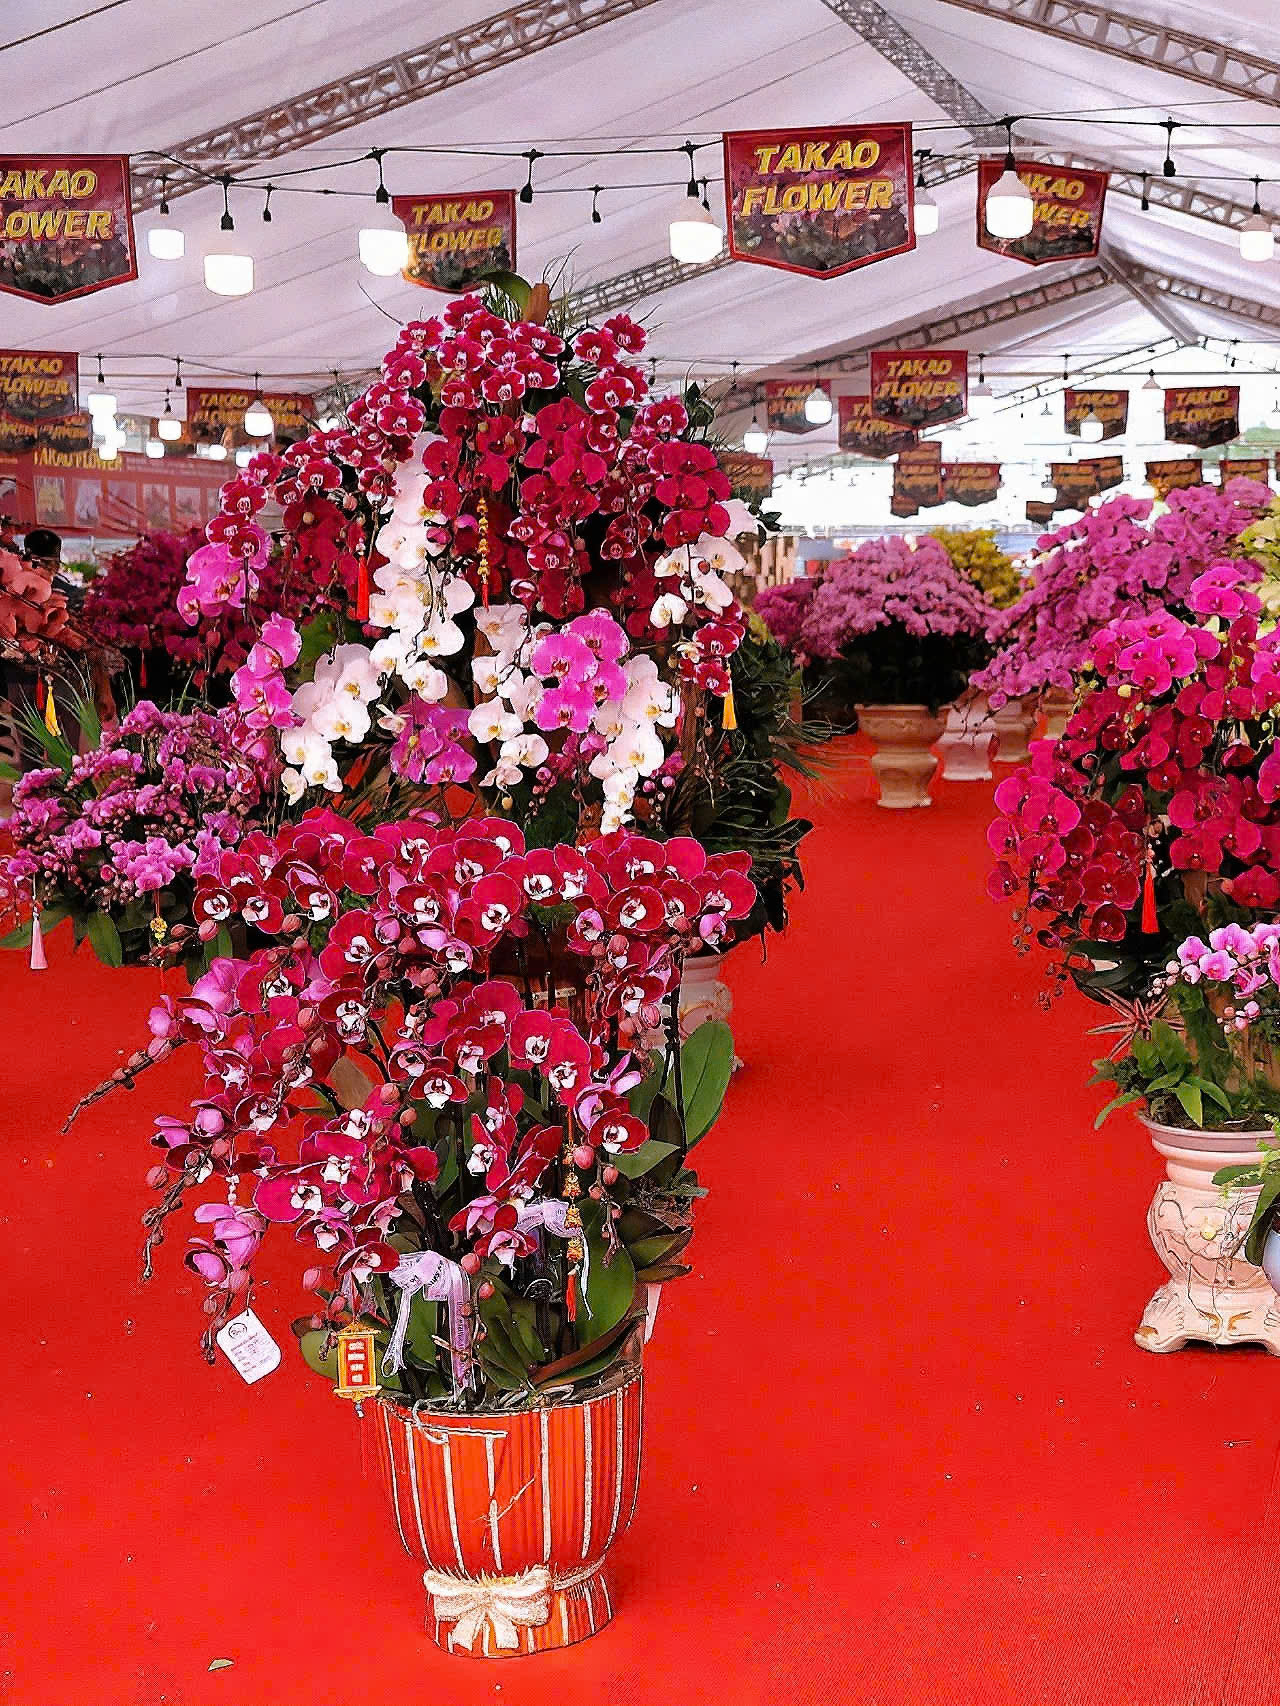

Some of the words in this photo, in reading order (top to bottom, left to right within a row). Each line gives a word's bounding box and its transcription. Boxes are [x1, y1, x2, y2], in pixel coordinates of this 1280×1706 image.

[754, 139, 880, 175] TAKAO
[0, 169, 98, 200] AKAO
[740, 178, 895, 217] FLOWER
[0, 209, 113, 240] OWER
[411, 200, 495, 225] TAKAO
[887, 359, 953, 377] TAKAO
[878, 381, 964, 398] FLOWER
